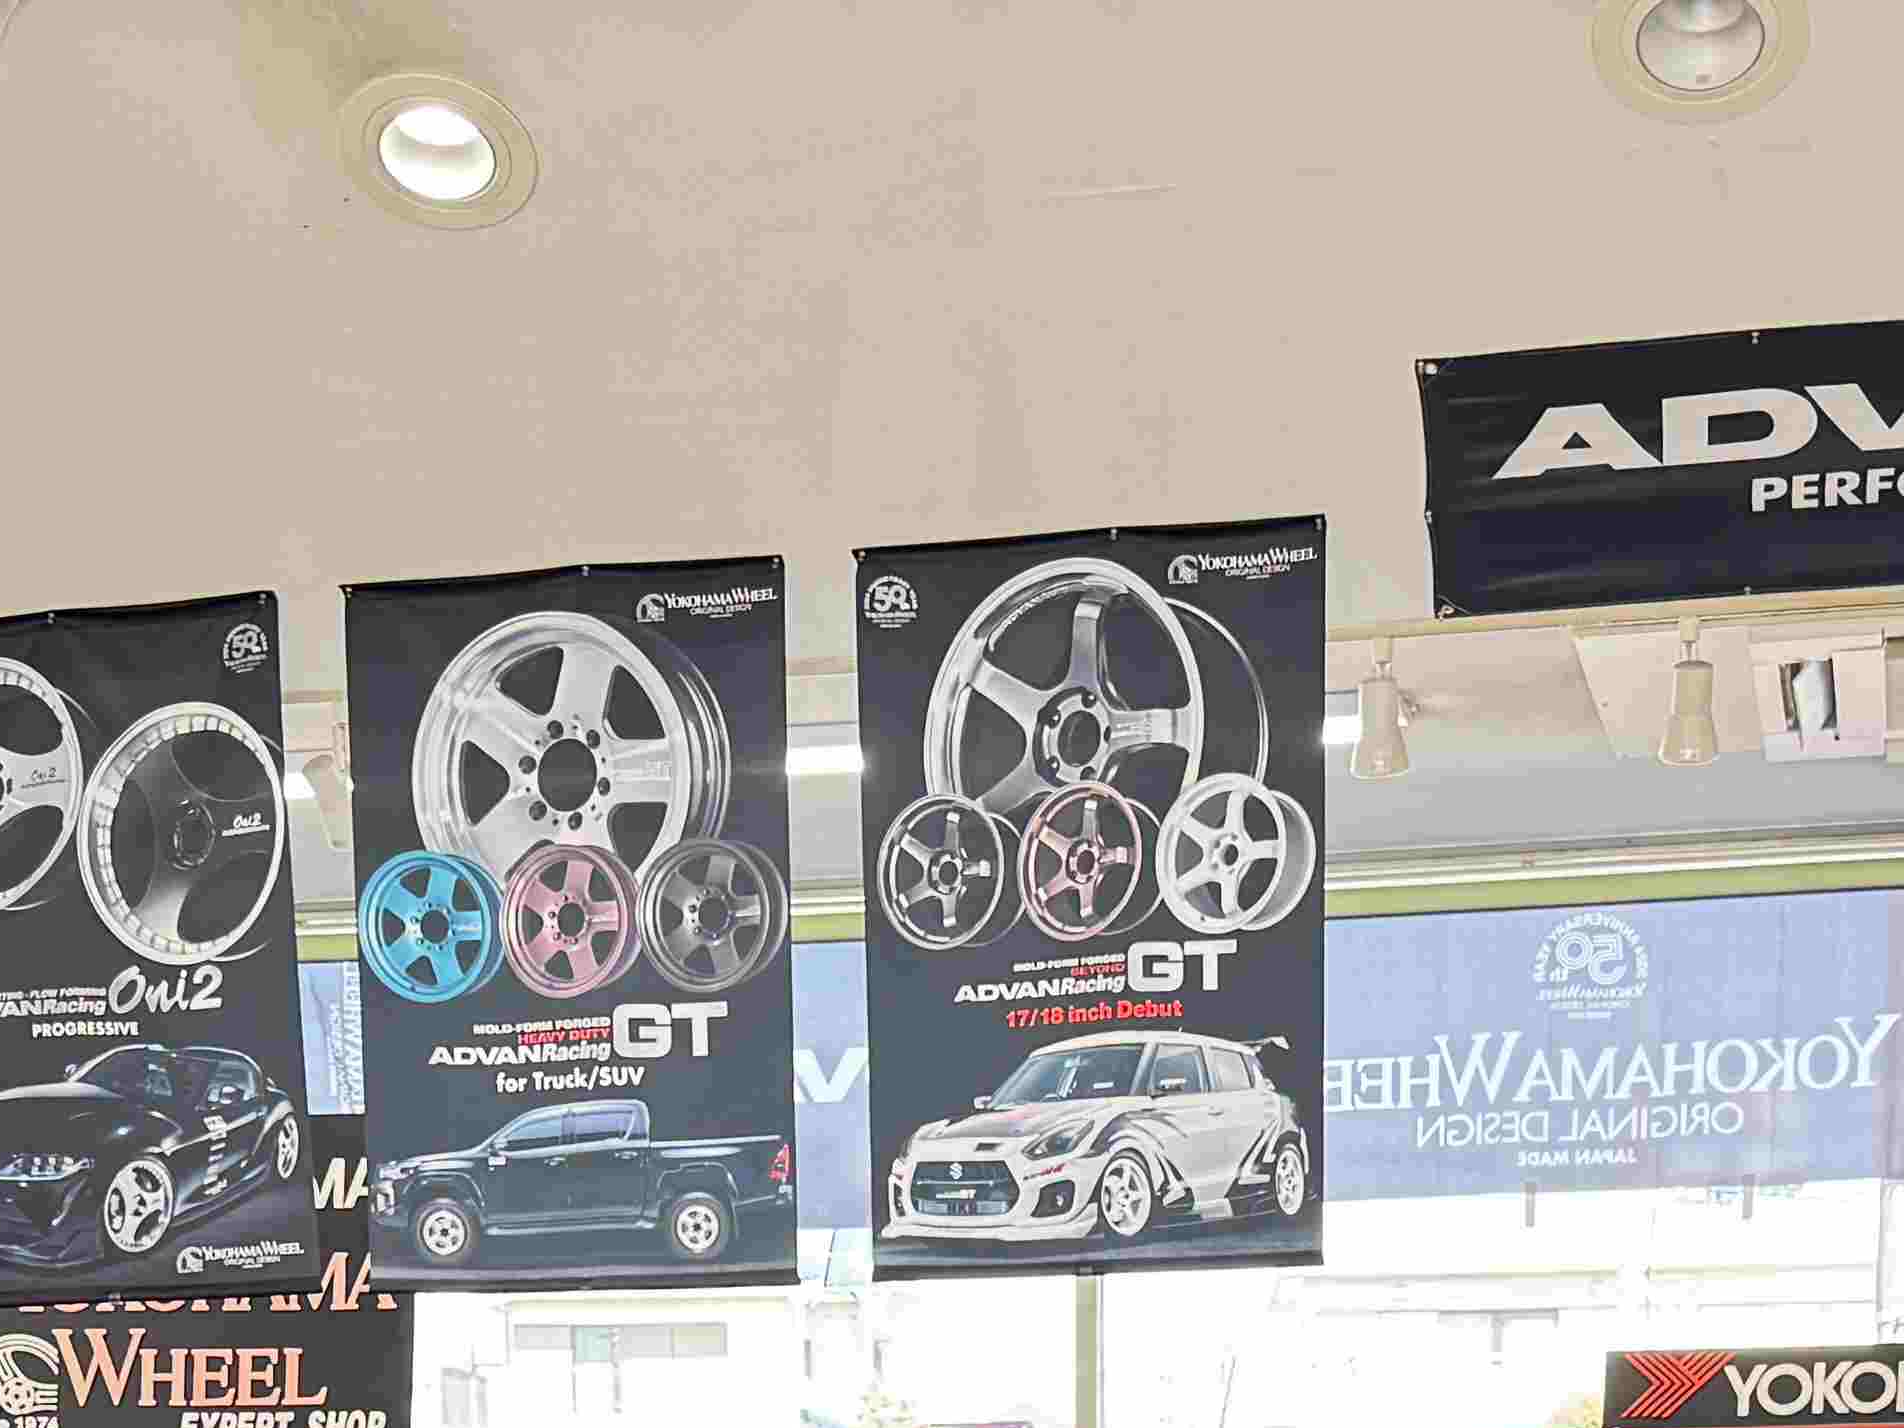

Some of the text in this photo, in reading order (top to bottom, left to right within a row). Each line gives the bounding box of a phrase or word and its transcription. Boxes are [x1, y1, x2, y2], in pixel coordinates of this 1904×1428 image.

[107, 964, 225, 1014] Oni2
[1126, 938, 1239, 993] GT
[31, 1021, 140, 1039] PROGRESSIVE
[612, 1000, 729, 1058] GT
[1006, 999, 1184, 1029] 17/18 inch Debut
[495, 1066, 646, 1094] for Truck/SUV
[51, 1327, 328, 1409] WHEEL
